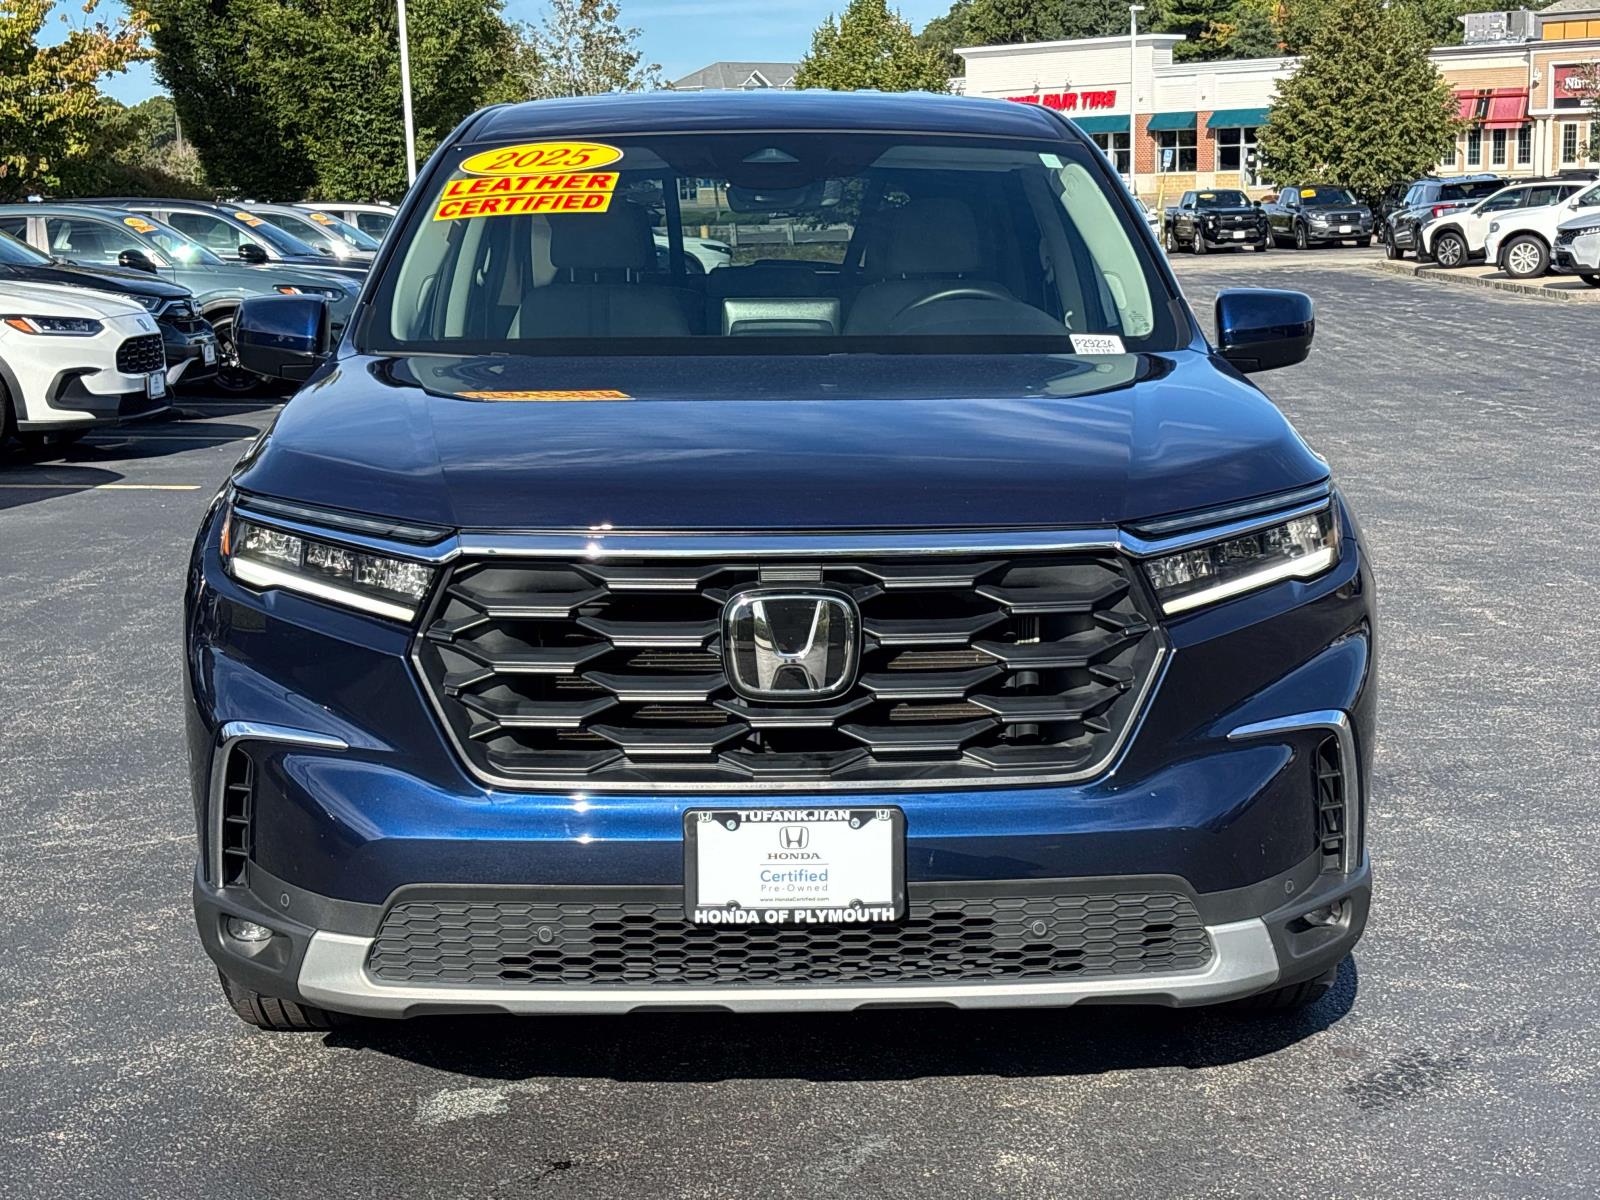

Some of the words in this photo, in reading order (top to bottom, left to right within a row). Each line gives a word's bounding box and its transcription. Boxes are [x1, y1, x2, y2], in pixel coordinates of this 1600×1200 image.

[1042, 93, 1079, 111] FAIR
[1081, 90, 1117, 110] TIRE
[483, 147, 599, 171] 2025
[447, 174, 613, 197] LEATHER
[438, 194, 605, 218] CERTIFIED
[737, 809, 851, 822] TUFANKJIAN
[767, 852, 822, 860] HONDA
[760, 868, 829, 883] Certified
[760, 883, 829, 893] Pre-Owned
[694, 909, 761, 924] HONDA
[764, 909, 790, 924] OF
[794, 907, 896, 923] PLYMOUTH
